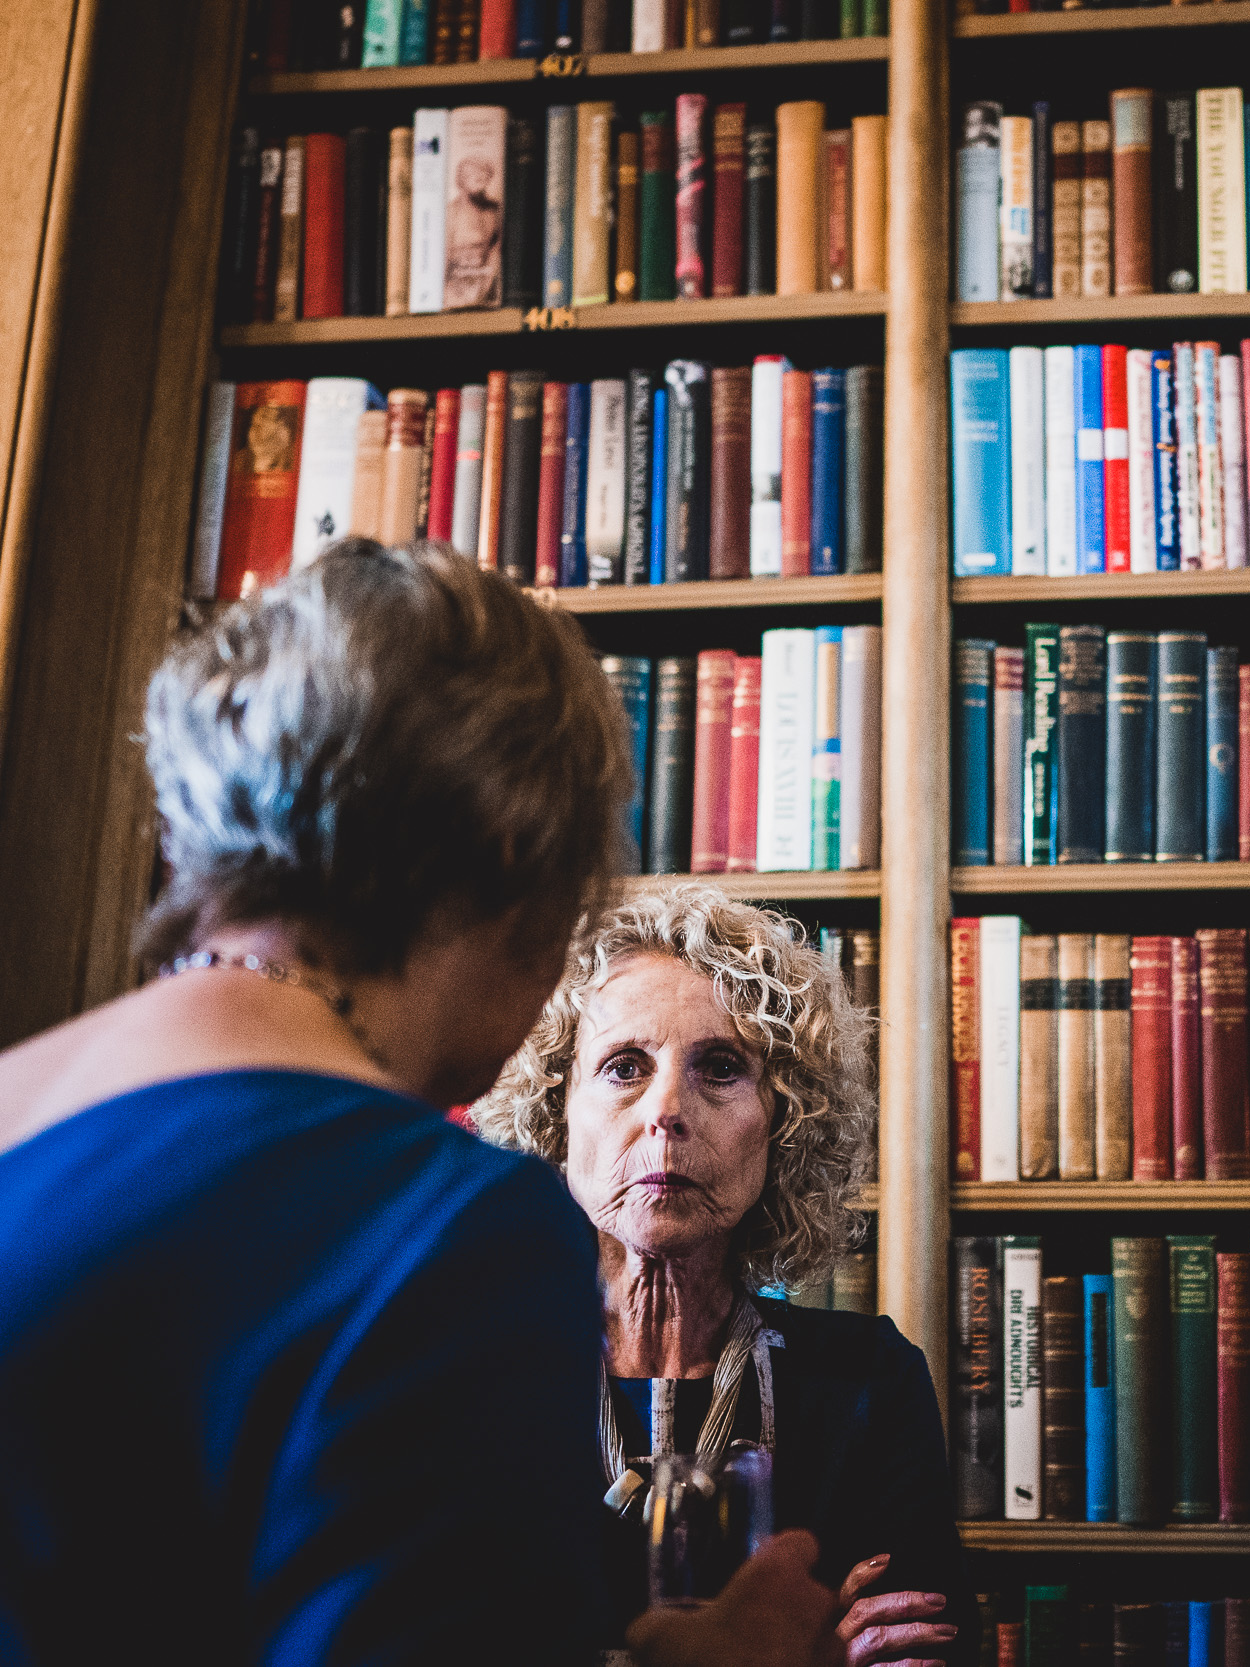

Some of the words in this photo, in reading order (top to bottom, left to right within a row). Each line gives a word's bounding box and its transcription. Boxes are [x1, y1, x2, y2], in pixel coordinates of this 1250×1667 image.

[540, 54, 582, 77] 407
[1035, 637, 1057, 680] Lord
[1030, 681, 1056, 753] Reading
[996, 1005, 1010, 1068] LEGACY
[971, 1267, 991, 1390] ROSEBERY
[1009, 1289, 1023, 1408] DREADNOUGHTS
[1026, 1305, 1041, 1389] HISTORICAL
